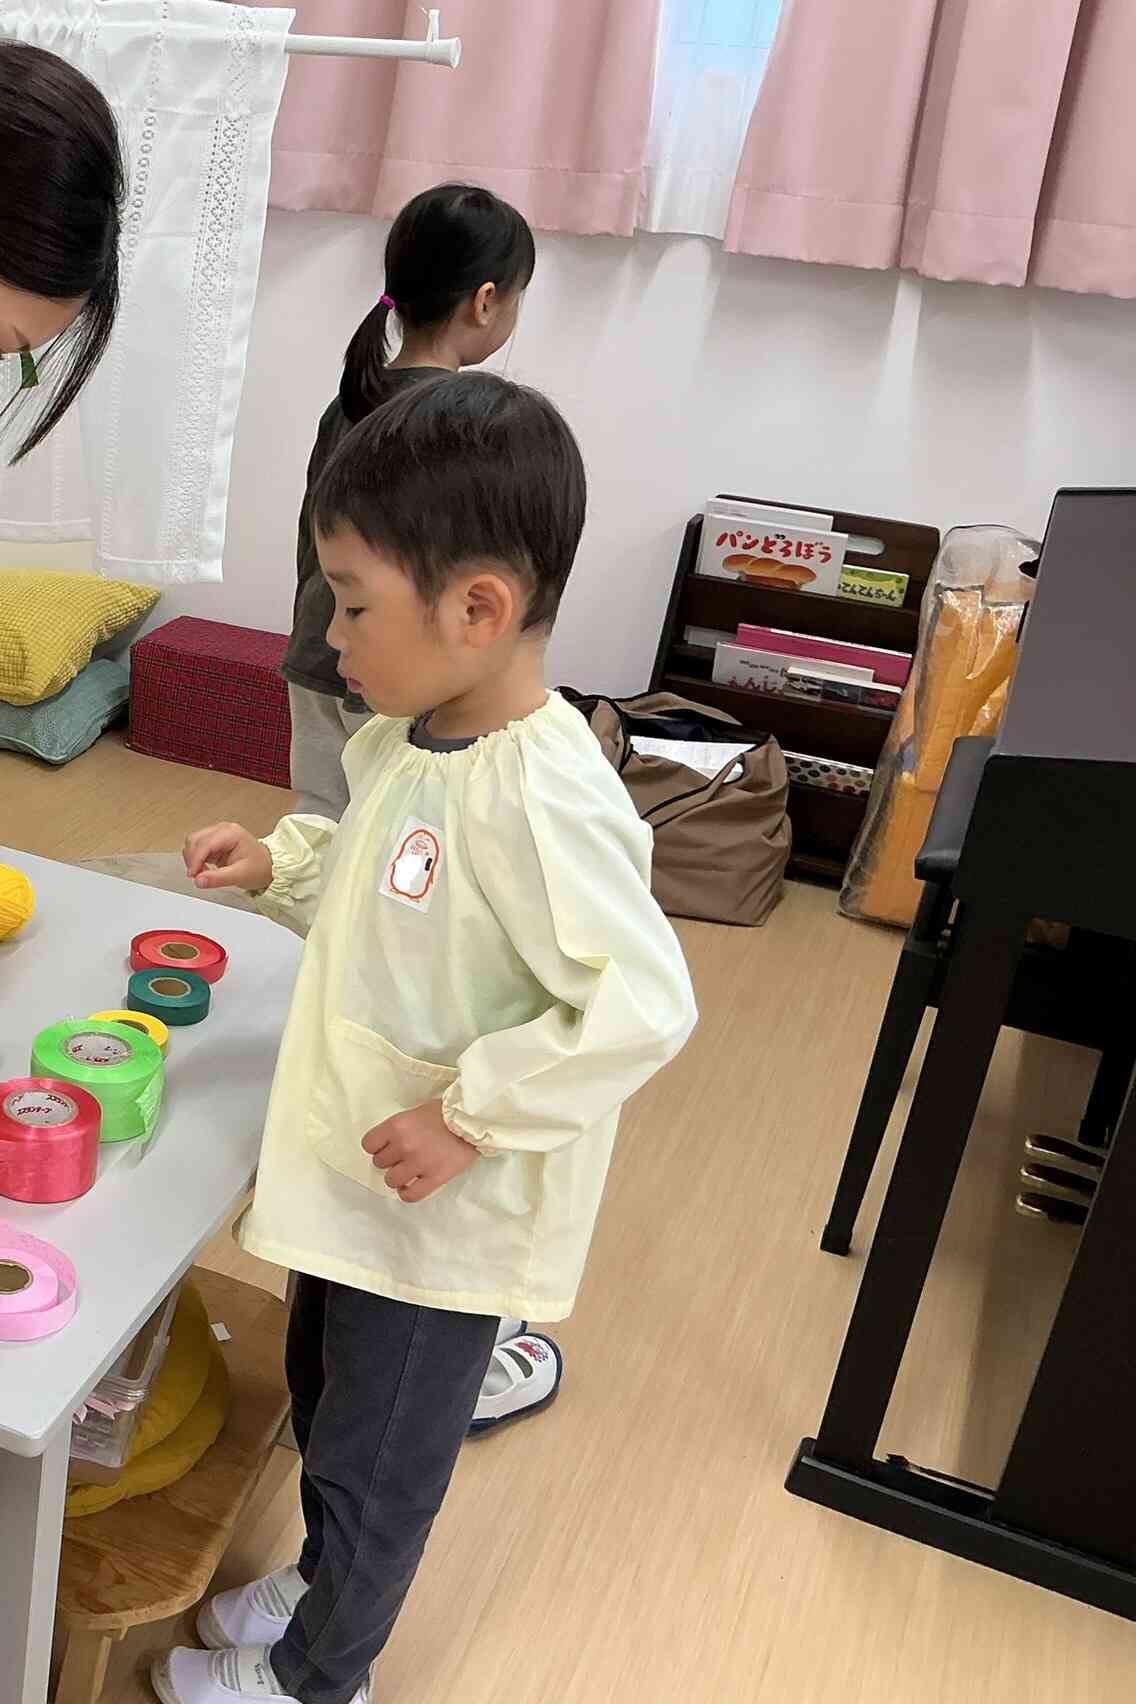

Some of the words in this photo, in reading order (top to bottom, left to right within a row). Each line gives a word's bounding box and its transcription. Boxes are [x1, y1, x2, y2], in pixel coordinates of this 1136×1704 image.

[716, 530, 832, 563] パンどろぼう
